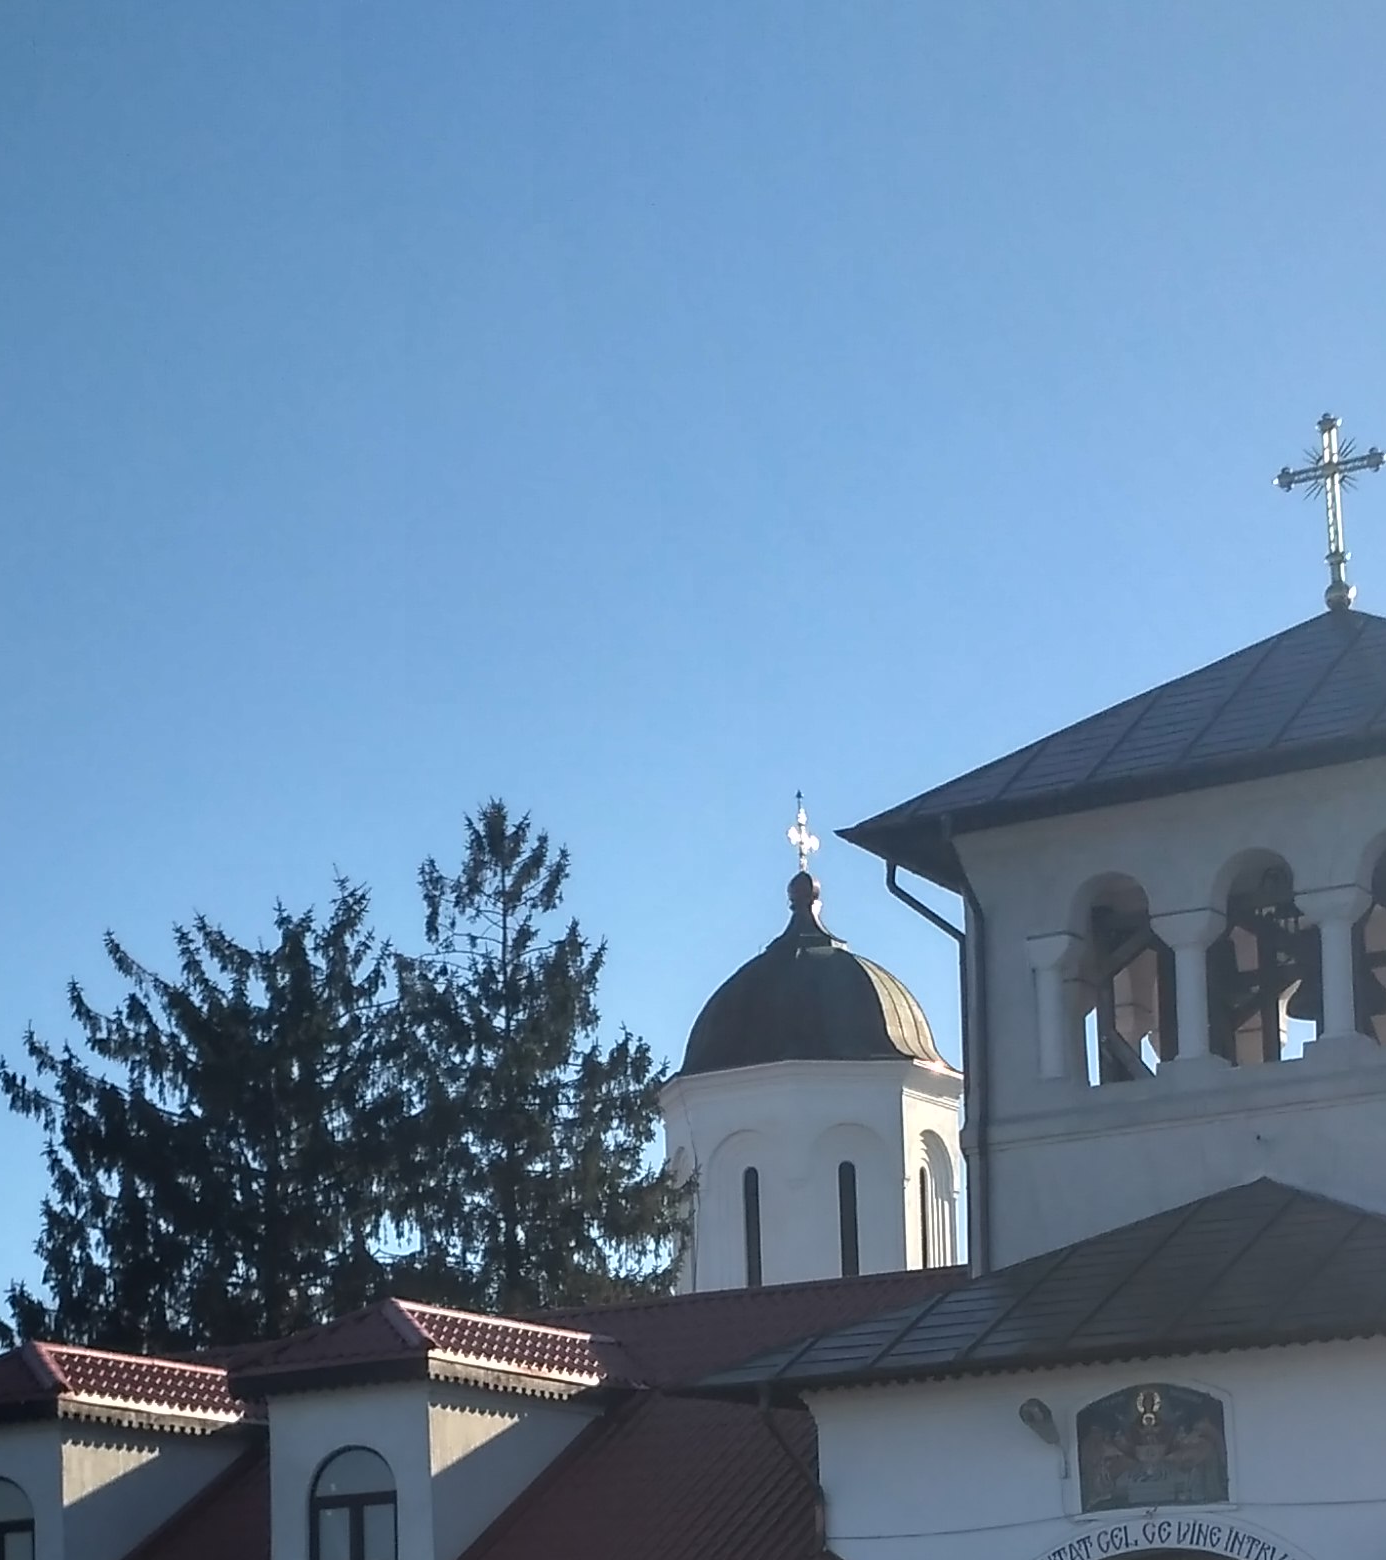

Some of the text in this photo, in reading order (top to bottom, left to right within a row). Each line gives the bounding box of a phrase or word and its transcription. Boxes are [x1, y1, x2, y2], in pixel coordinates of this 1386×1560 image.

[1097, 1525, 1138, 1554] CEL
[1142, 1520, 1172, 1545] CE
[1176, 1519, 1222, 1549] VINE
